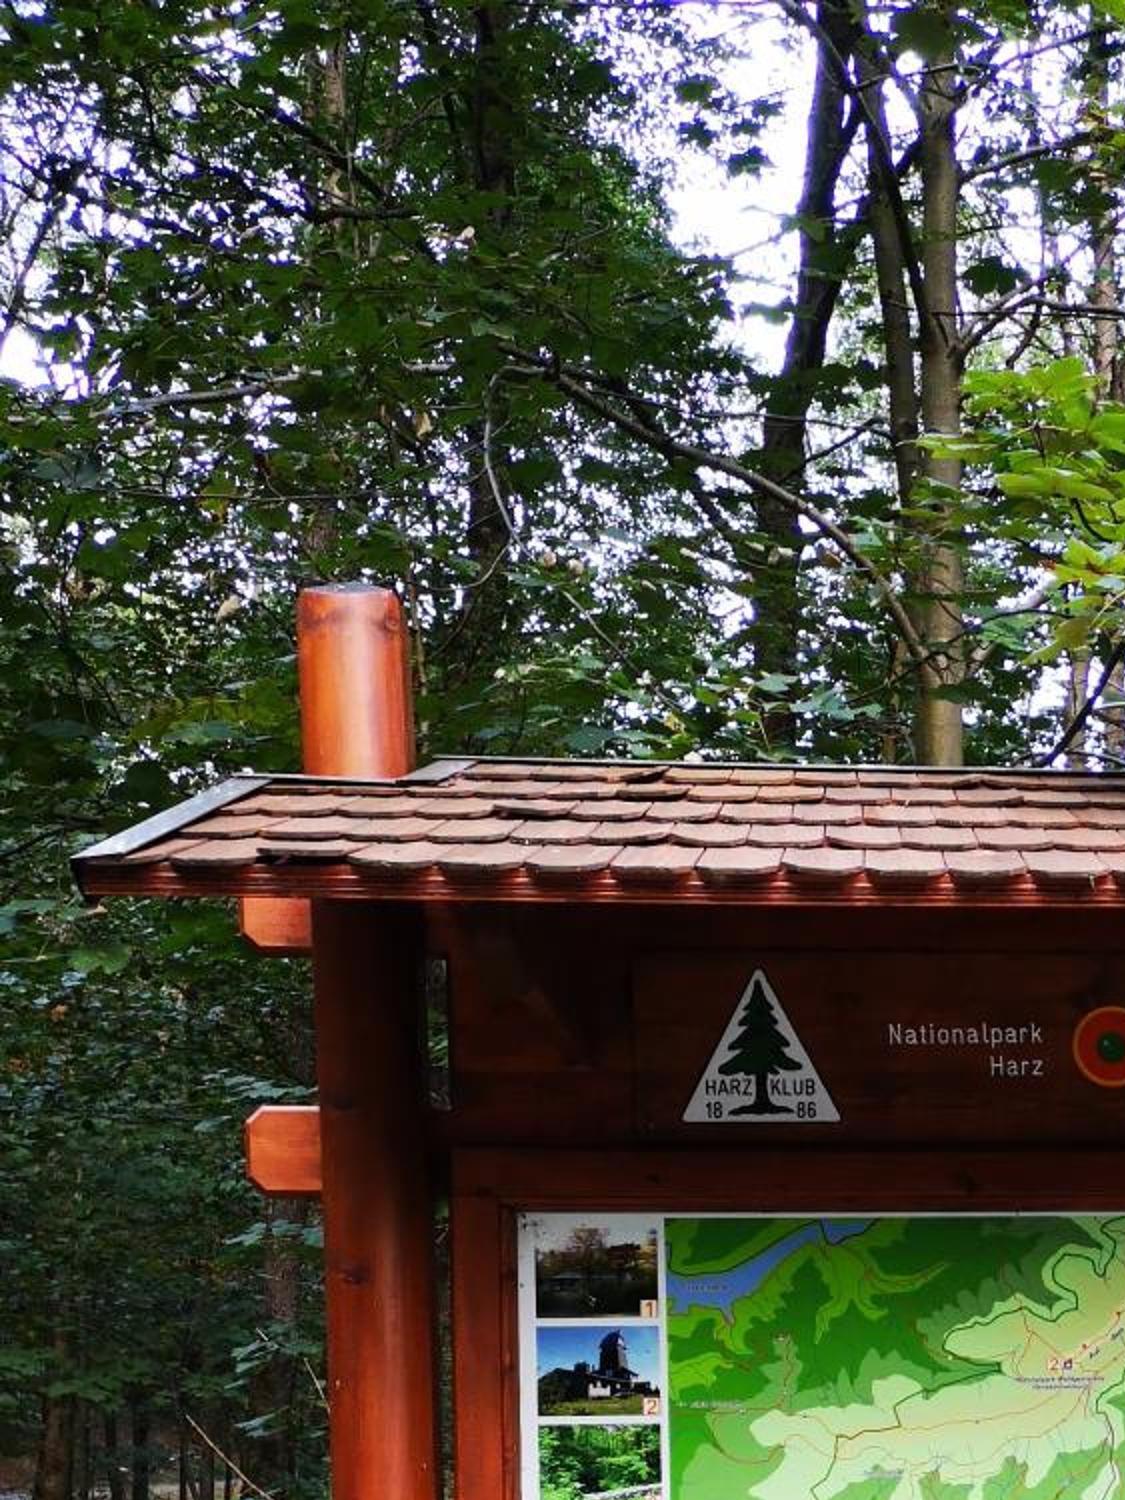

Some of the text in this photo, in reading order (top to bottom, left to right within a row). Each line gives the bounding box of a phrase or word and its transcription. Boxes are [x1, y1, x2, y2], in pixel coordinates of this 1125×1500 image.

[888, 1021, 1042, 1048] Nationalpark
[989, 1055, 1043, 1076] Harz
[705, 1078, 816, 1096] HARZ KLUB
[705, 1101, 817, 1118] 18 86
